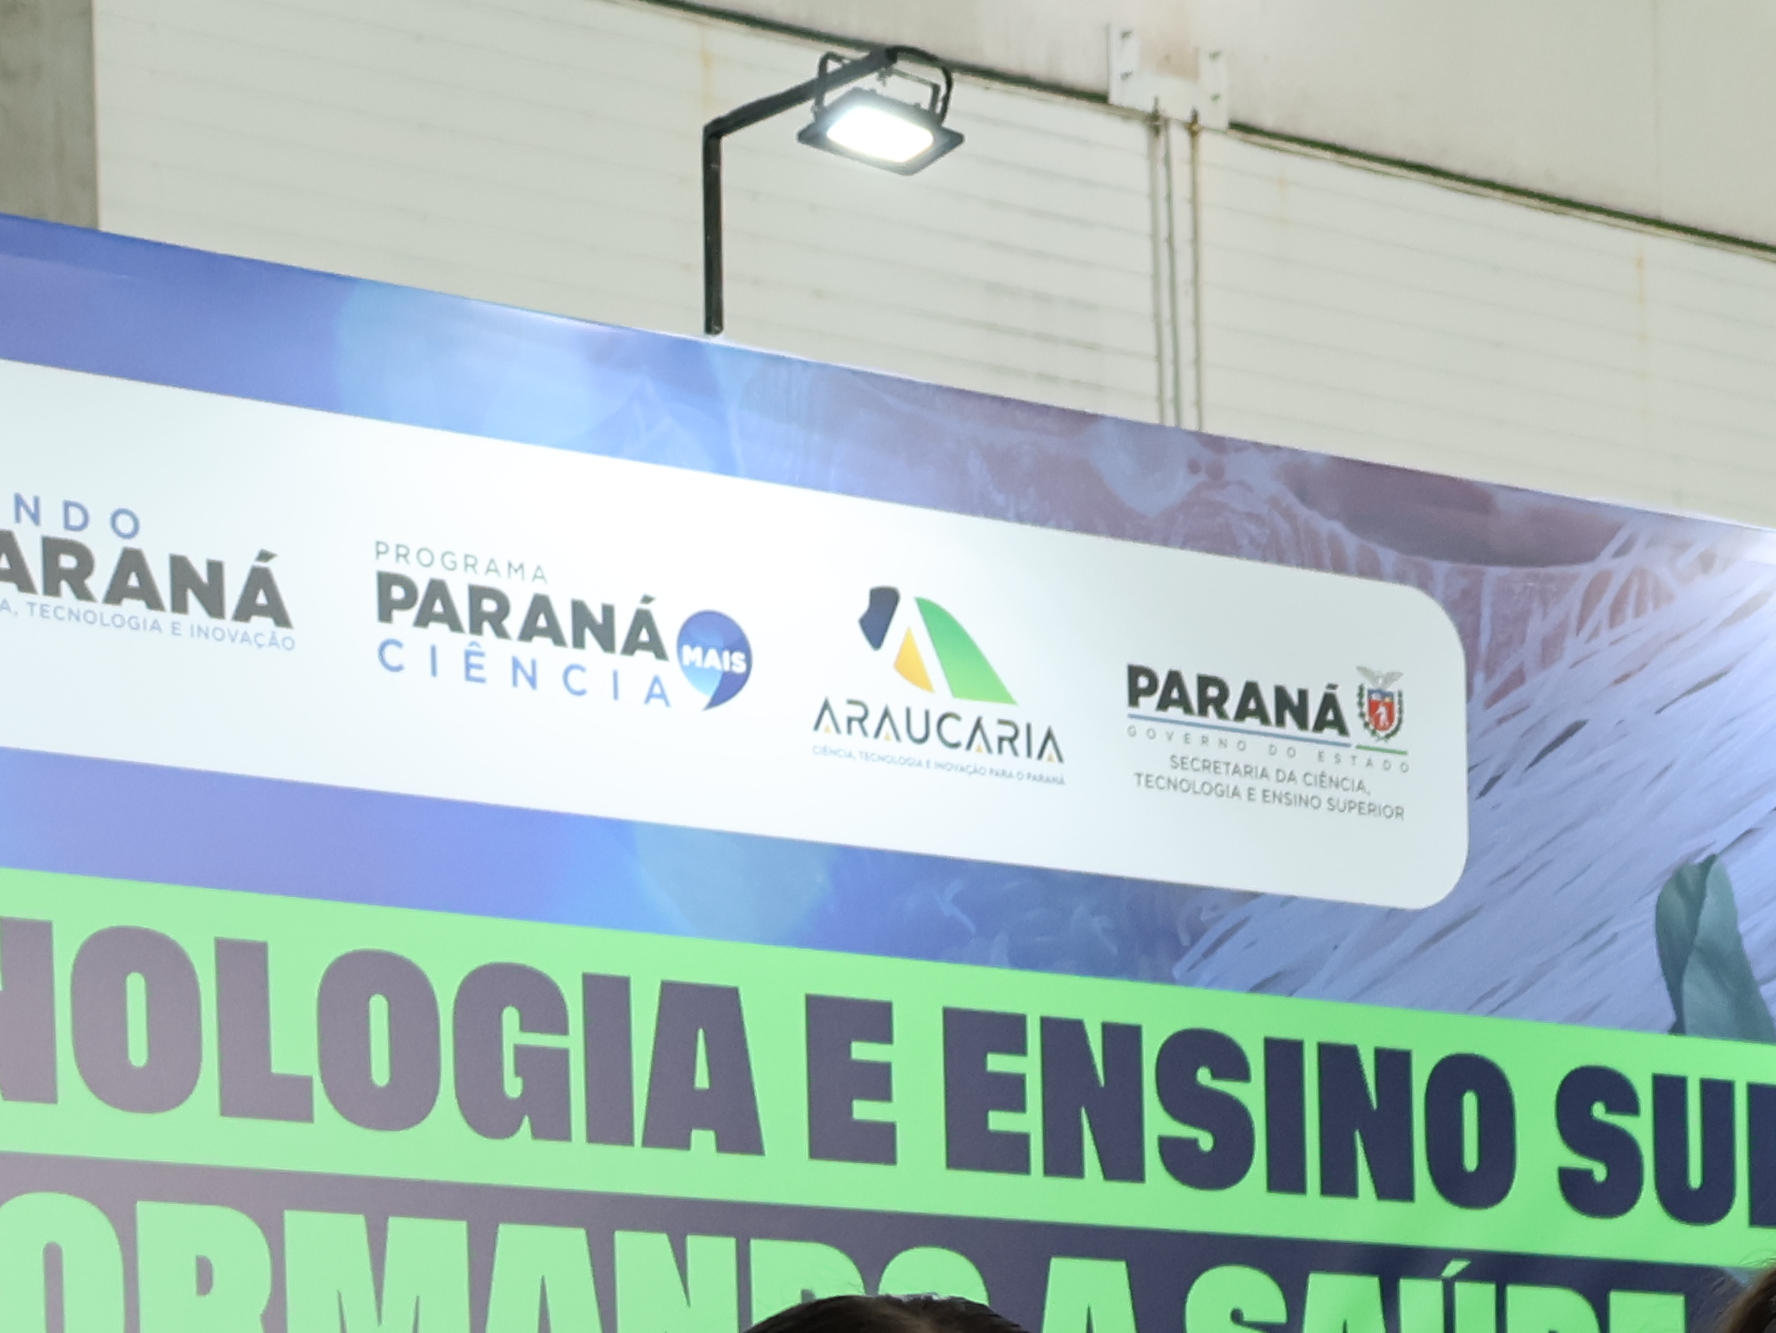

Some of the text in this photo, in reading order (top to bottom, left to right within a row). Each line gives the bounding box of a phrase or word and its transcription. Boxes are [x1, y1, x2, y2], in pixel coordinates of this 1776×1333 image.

[375, 540, 548, 584] PROGRAMA
[27, 602, 162, 634] TECNOLOGIA
[171, 621, 182, 636] E
[190, 624, 295, 652] INOVAÇÃO
[376, 570, 669, 661] PARANÁ
[378, 639, 670, 708] CIÊNCIA
[682, 645, 747, 674] MAIS
[1127, 664, 1350, 736] PARANÁ
[813, 696, 1065, 764] ARAUCARIA
[1127, 726, 1410, 773] GOVERNO DO ESTADO
[1134, 772, 1405, 821] TECNOLOGIA E ENSINO SUPERIOR
[1169, 755, 1371, 796] SECRETARIA DA CIÊNCIA,
[806, 993, 898, 1166] E
[942, 1005, 1517, 1210] ENSINO
